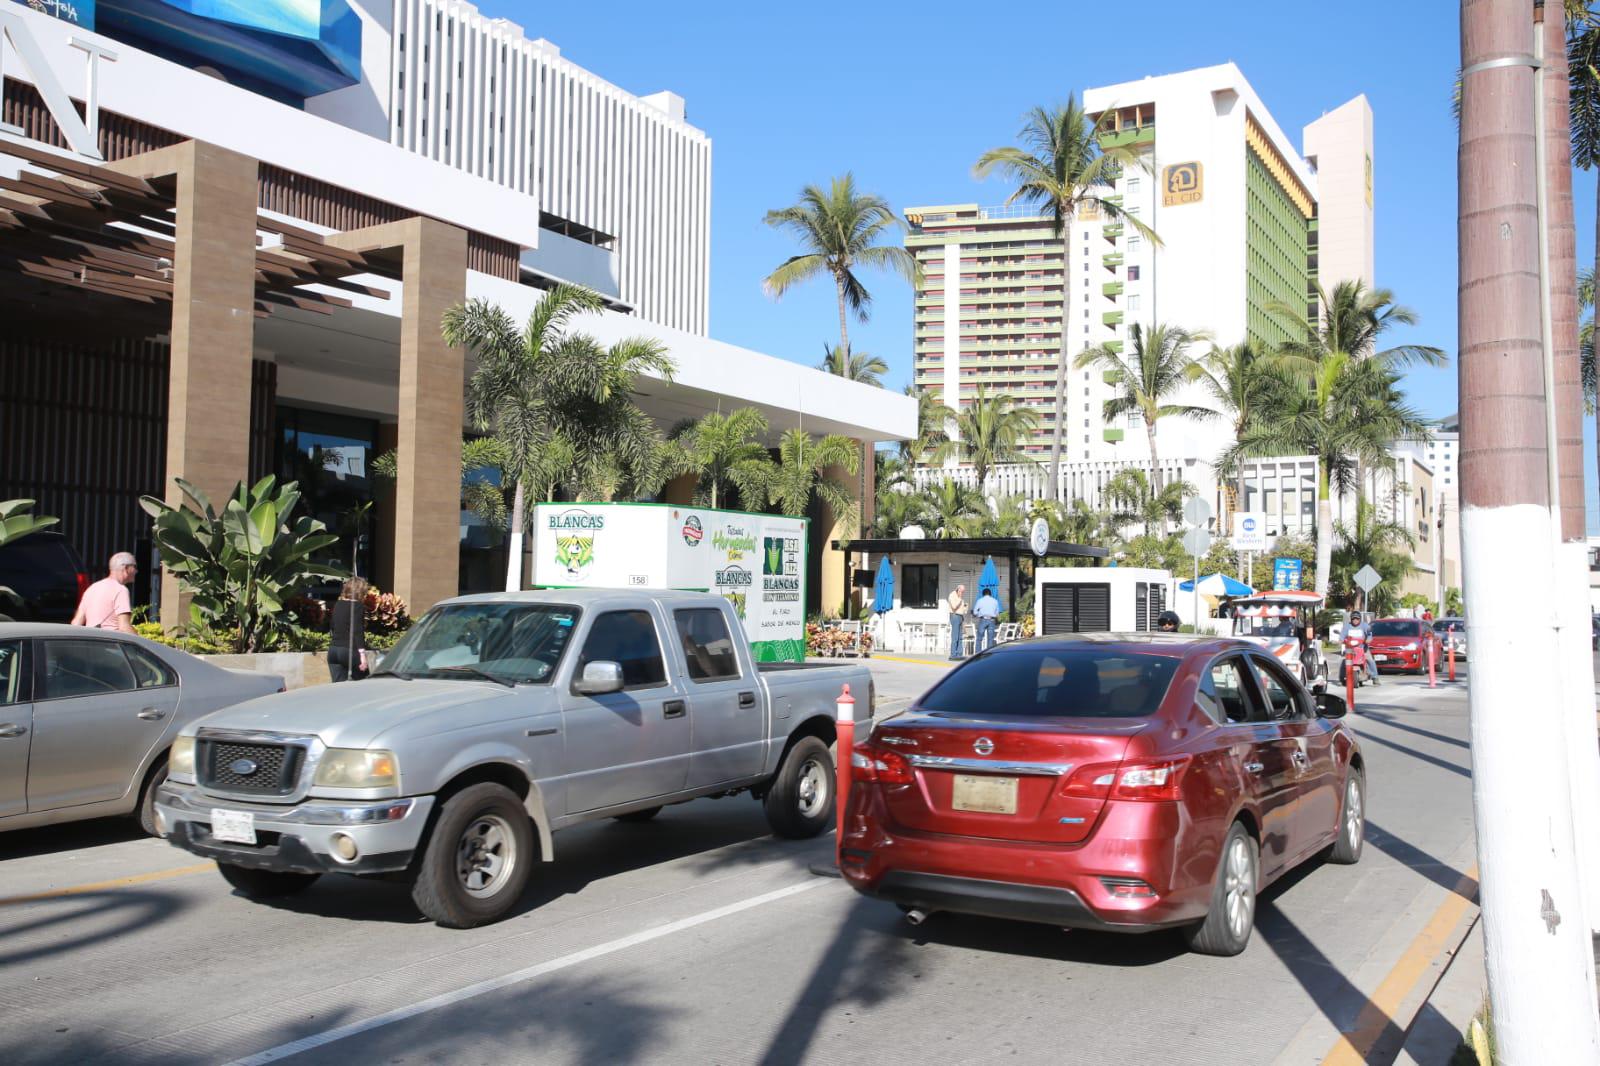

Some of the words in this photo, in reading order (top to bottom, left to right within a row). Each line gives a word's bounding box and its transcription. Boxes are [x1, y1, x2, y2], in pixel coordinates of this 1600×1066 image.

[1164, 196, 1176, 206] EL
[1181, 192, 1201, 202] CID
[549, 516, 604, 529] BLANCAS
[632, 576, 646, 585] 158
[716, 572, 752, 585] BLANCAS
[763, 579, 800, 590] BLANCAS
